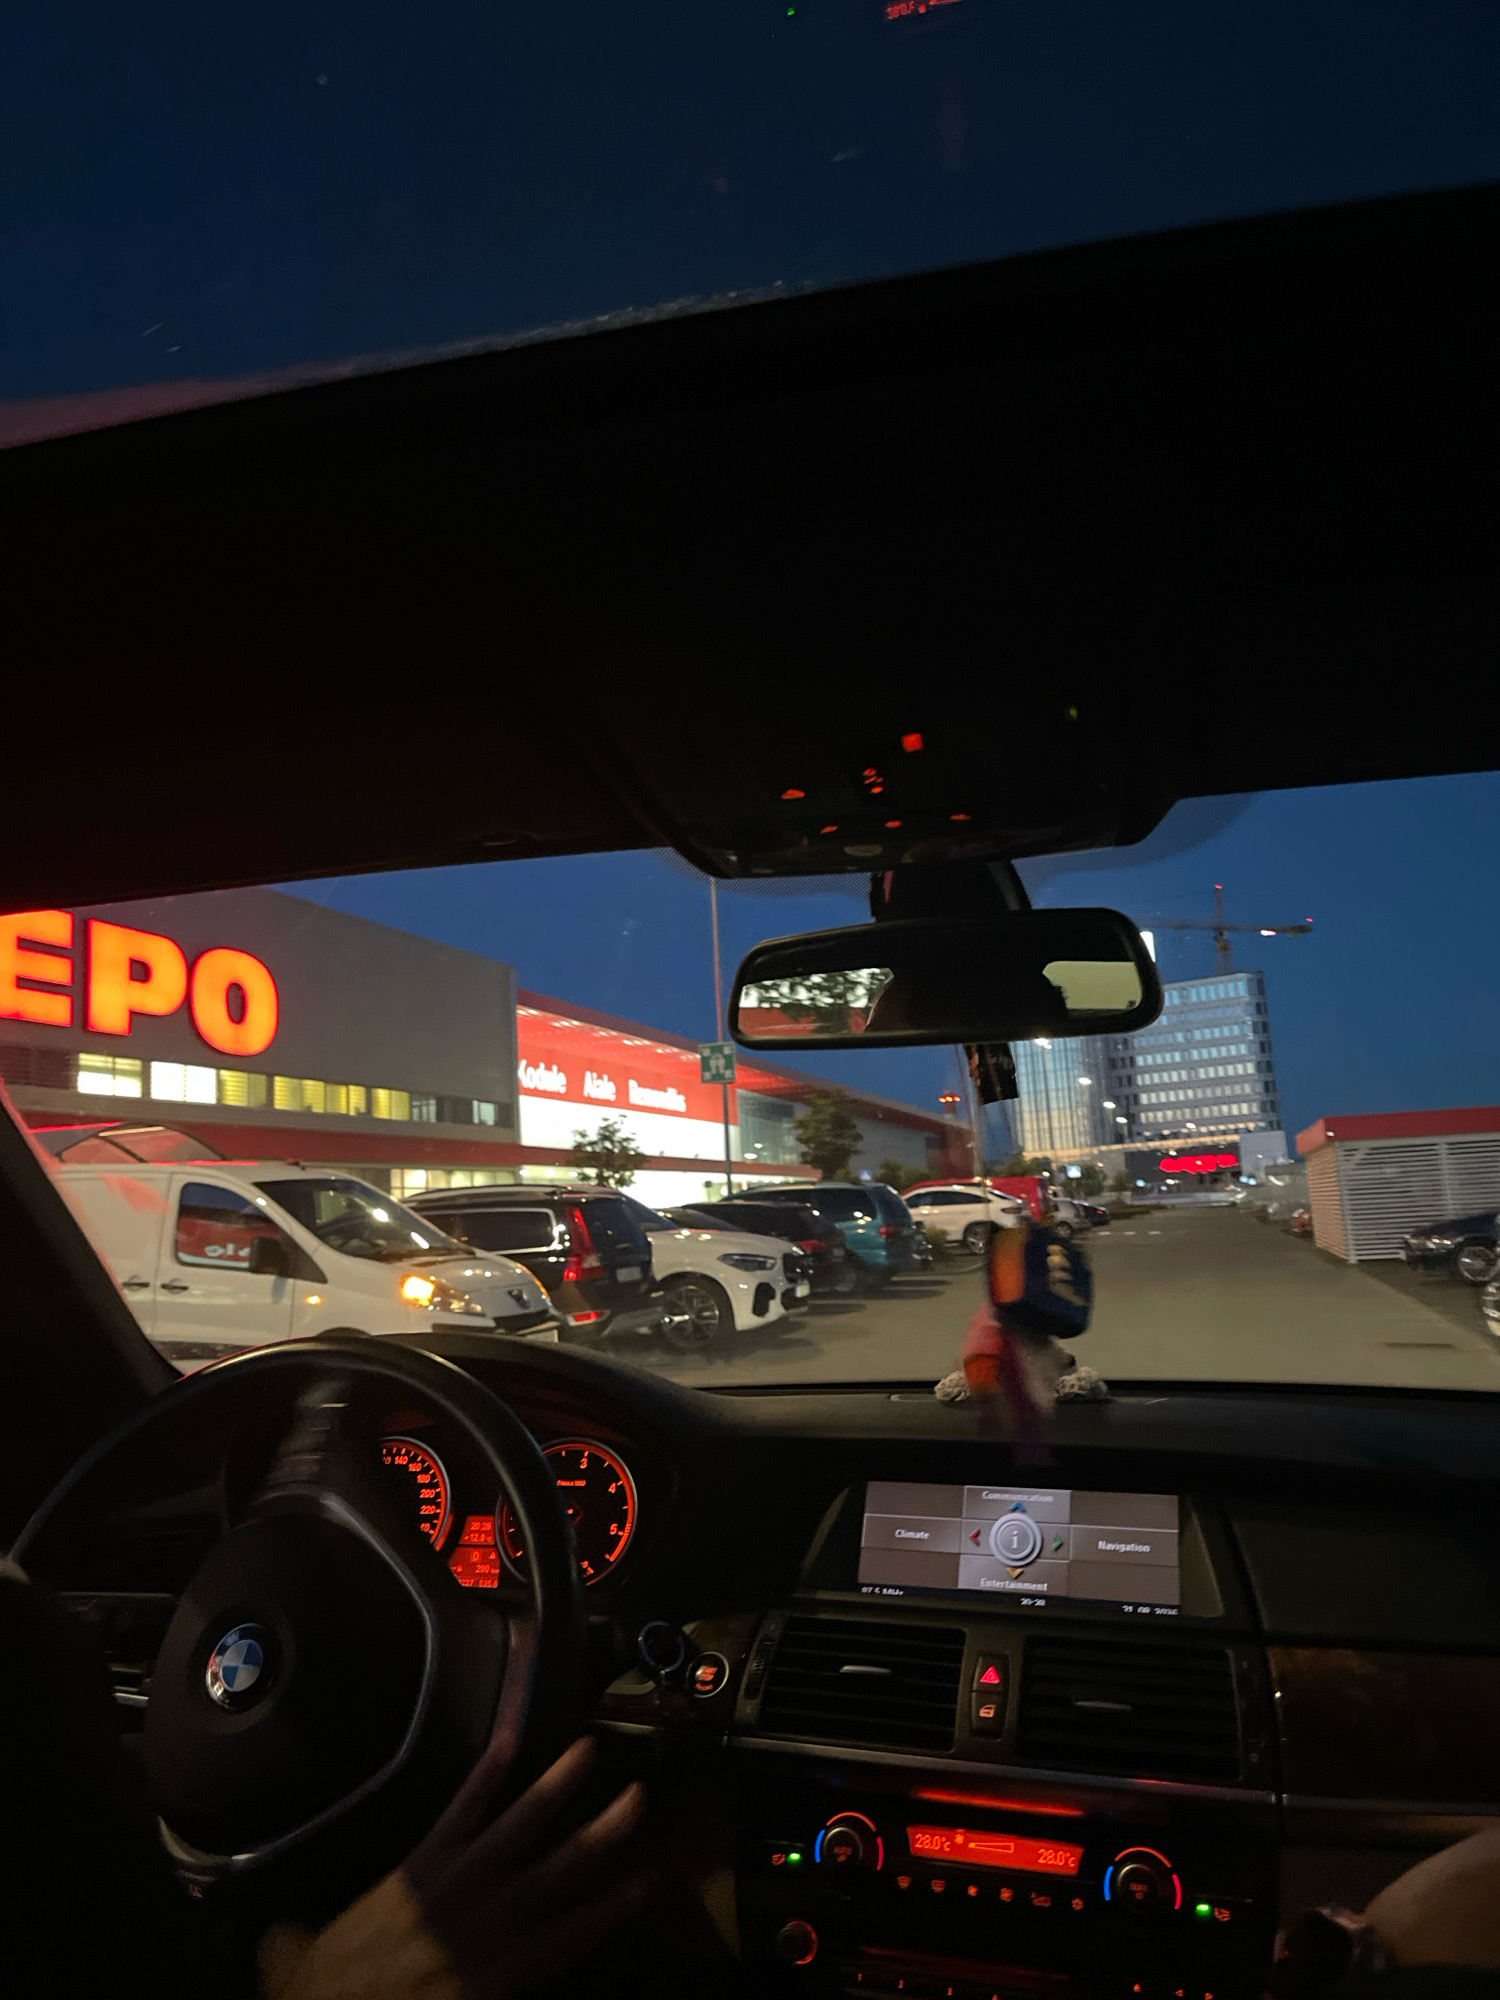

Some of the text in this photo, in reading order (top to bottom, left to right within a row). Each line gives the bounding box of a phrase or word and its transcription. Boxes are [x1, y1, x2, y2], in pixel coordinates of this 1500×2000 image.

[580, 1458, 588, 1469] 3
[419, 1489, 436, 1498] 200
[608, 1482, 616, 1493] 4
[981, 1490, 1054, 1502] Communication
[419, 1505, 436, 1515] 220
[609, 1523, 618, 1535] 5
[894, 1528, 930, 1540] Climate
[1097, 1540, 1151, 1553] Navigation
[980, 1577, 1049, 1592] Entertainment
